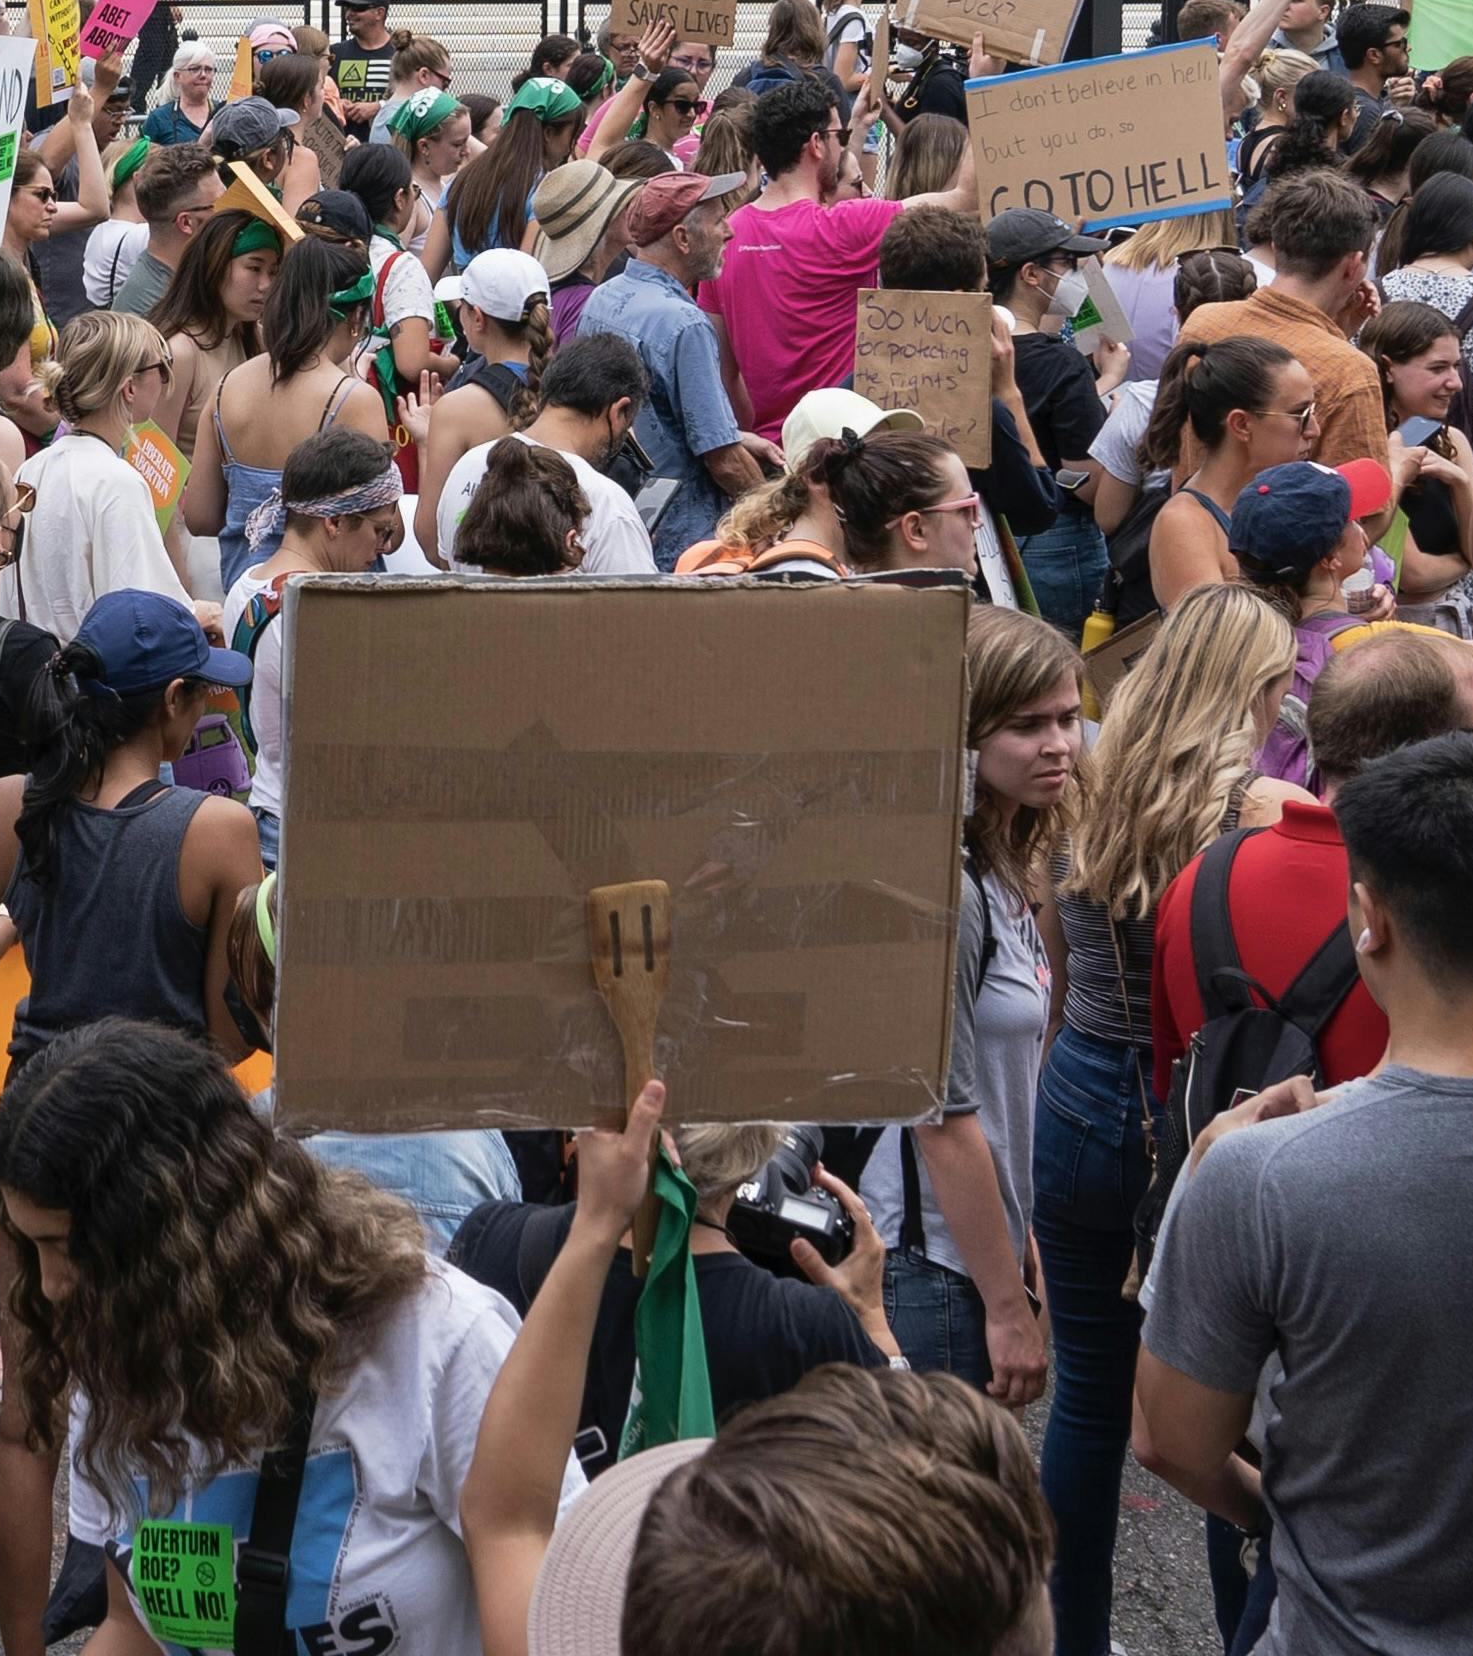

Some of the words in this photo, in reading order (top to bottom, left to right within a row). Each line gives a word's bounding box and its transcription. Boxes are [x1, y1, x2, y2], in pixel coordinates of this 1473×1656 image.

[97, 3, 132, 29] ABET
[683, 8, 731, 36] LIVES
[971, 90, 998, 120] I
[1009, 84, 1064, 113] don't
[1066, 73, 1137, 104] believe
[1145, 67, 1162, 85] in
[980, 137, 1027, 164] but
[1040, 129, 1078, 156] you
[1118, 120, 1135, 133] so
[1059, 169, 1114, 216] TO
[1125, 152, 1221, 208] HELL
[866, 297, 903, 331] So
[913, 306, 971, 337] Much
[856, 333, 880, 359] for
[888, 341, 969, 374] protecting
[856, 367, 880, 386] the
[888, 370, 958, 407] rights
[131, 449, 172, 500] ABORTION
[142, 437, 178, 484] LIBERATE
[139, 1527, 220, 1557] OVERTURN
[140, 1555, 180, 1582] ROE?
[140, 1586, 191, 1620] HELL
[193, 1590, 230, 1623] NO!
